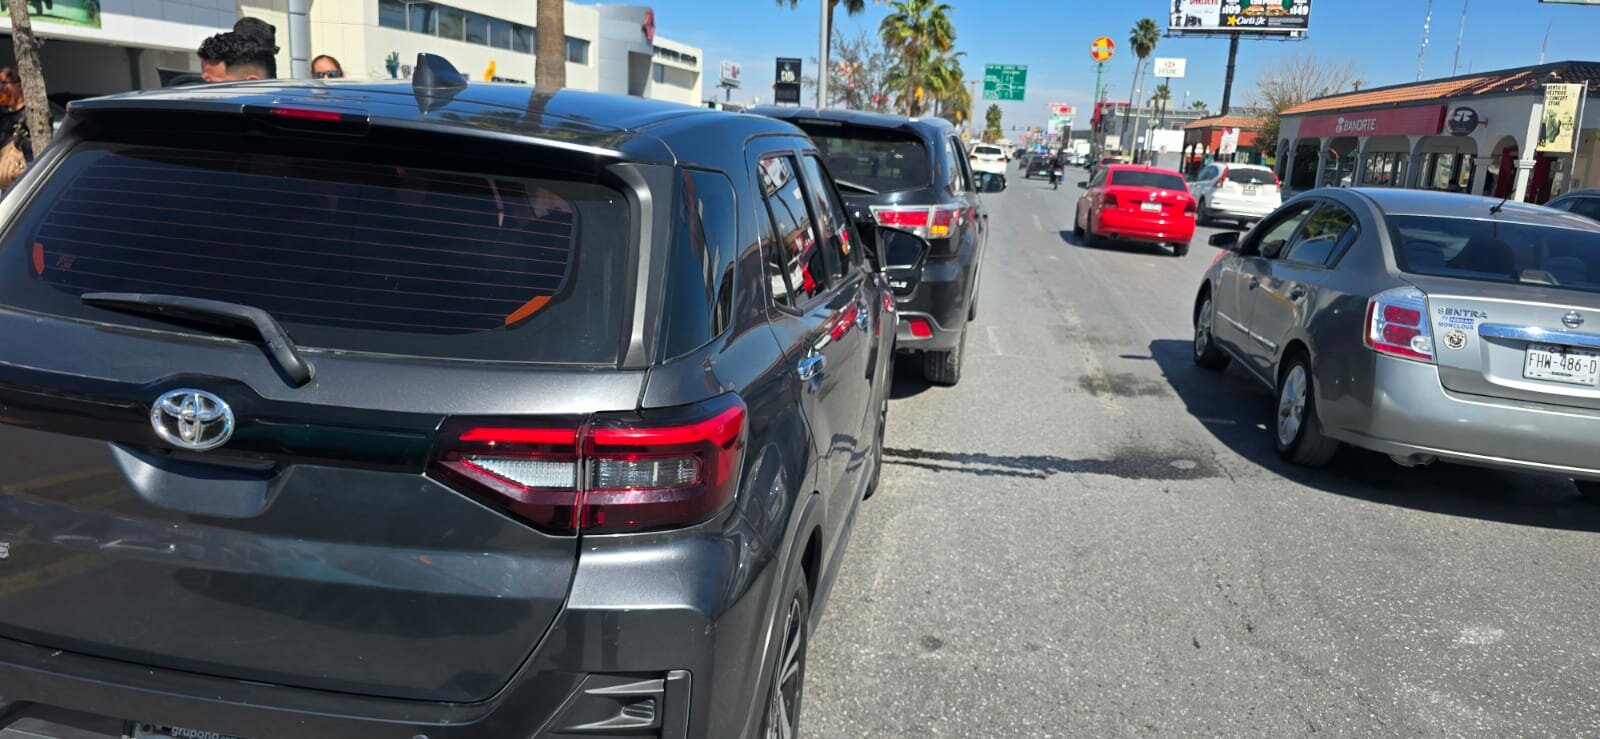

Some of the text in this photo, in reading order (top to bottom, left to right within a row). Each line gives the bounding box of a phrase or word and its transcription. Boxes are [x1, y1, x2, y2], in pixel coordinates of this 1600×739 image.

[1344, 118, 1377, 131] BANORTE
[1438, 307, 1488, 319] SENTRA
[1438, 321, 1474, 330] MONCLOVA
[1528, 352, 1597, 375] FHW-486-D
